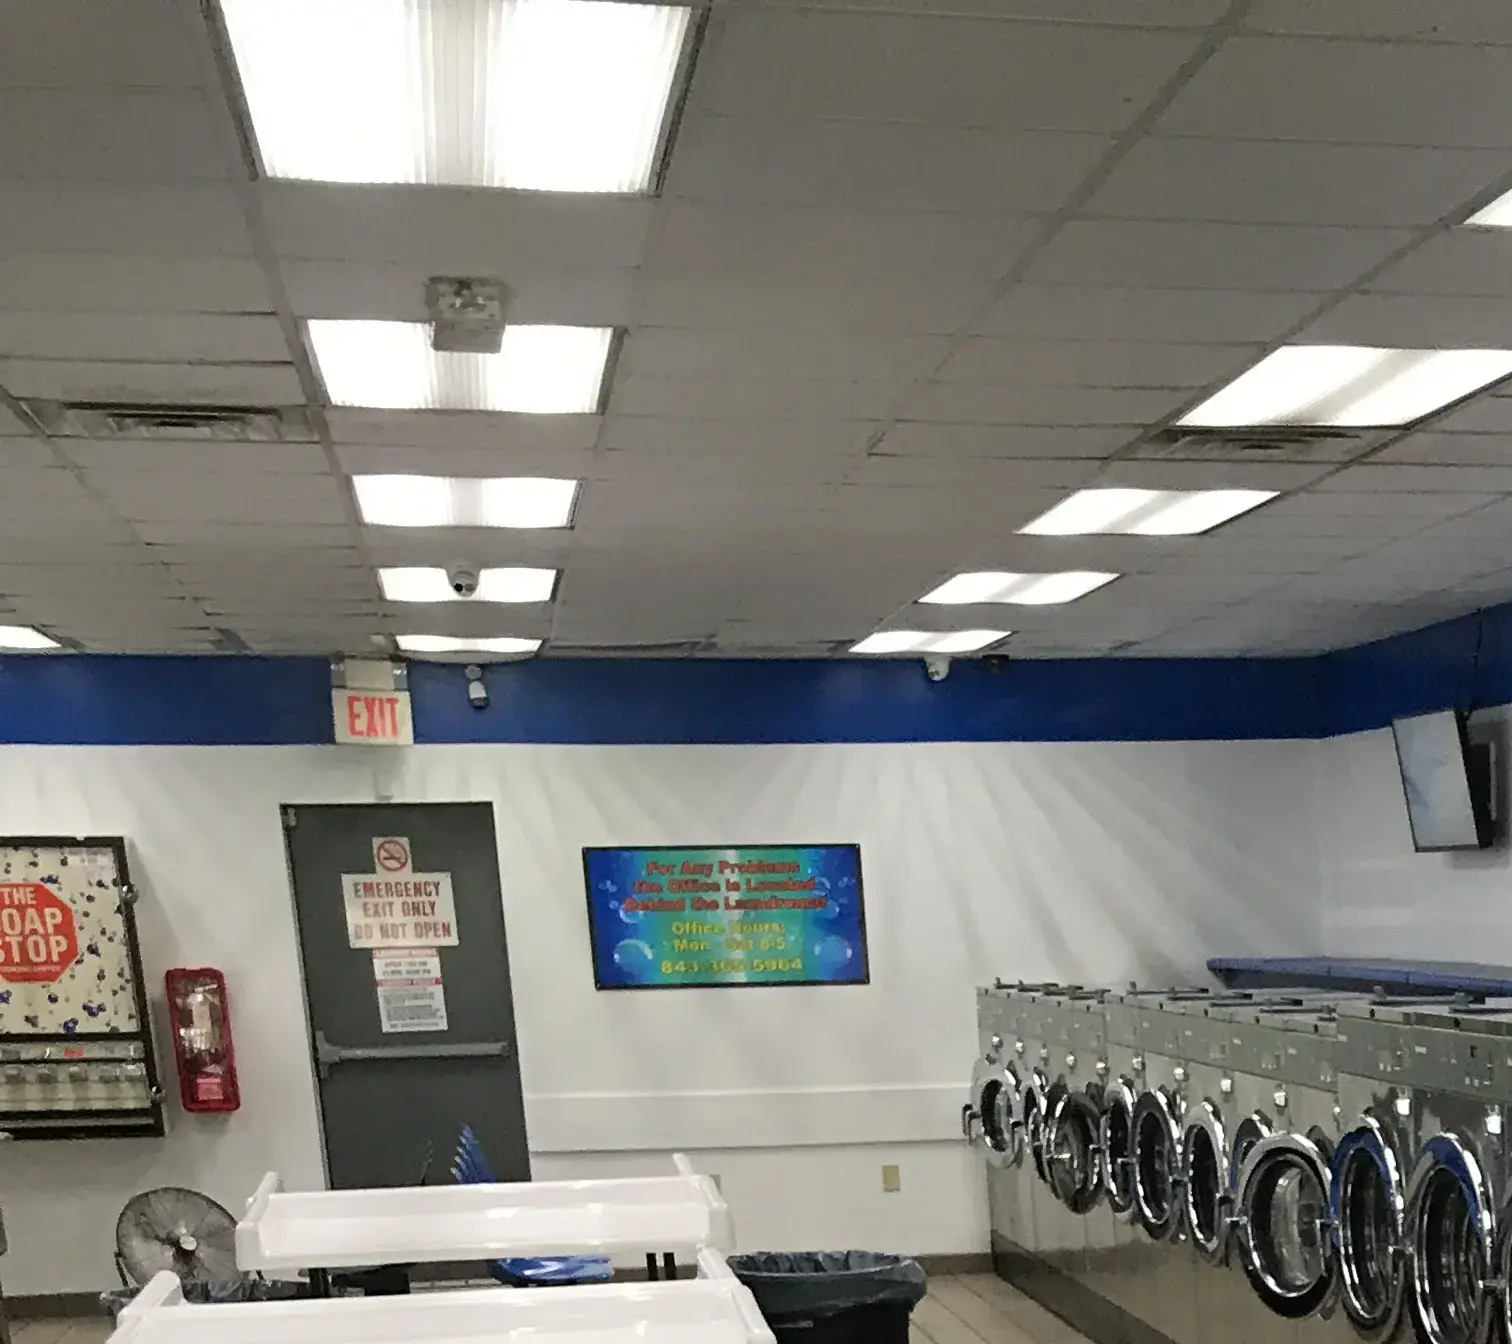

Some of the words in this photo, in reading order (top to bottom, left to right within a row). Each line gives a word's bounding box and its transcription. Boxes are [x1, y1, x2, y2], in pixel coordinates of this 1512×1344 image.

[347, 695, 400, 737] EXIT
[0, 886, 37, 905] THE
[353, 880, 441, 899] EMERGENCY
[362, 901, 395, 918] EXIT
[401, 900, 436, 917] ONLY
[0, 907, 63, 936] OAP
[353, 923, 373, 940] DO
[380, 922, 407, 940] NOT
[414, 921, 452, 939] OPEN
